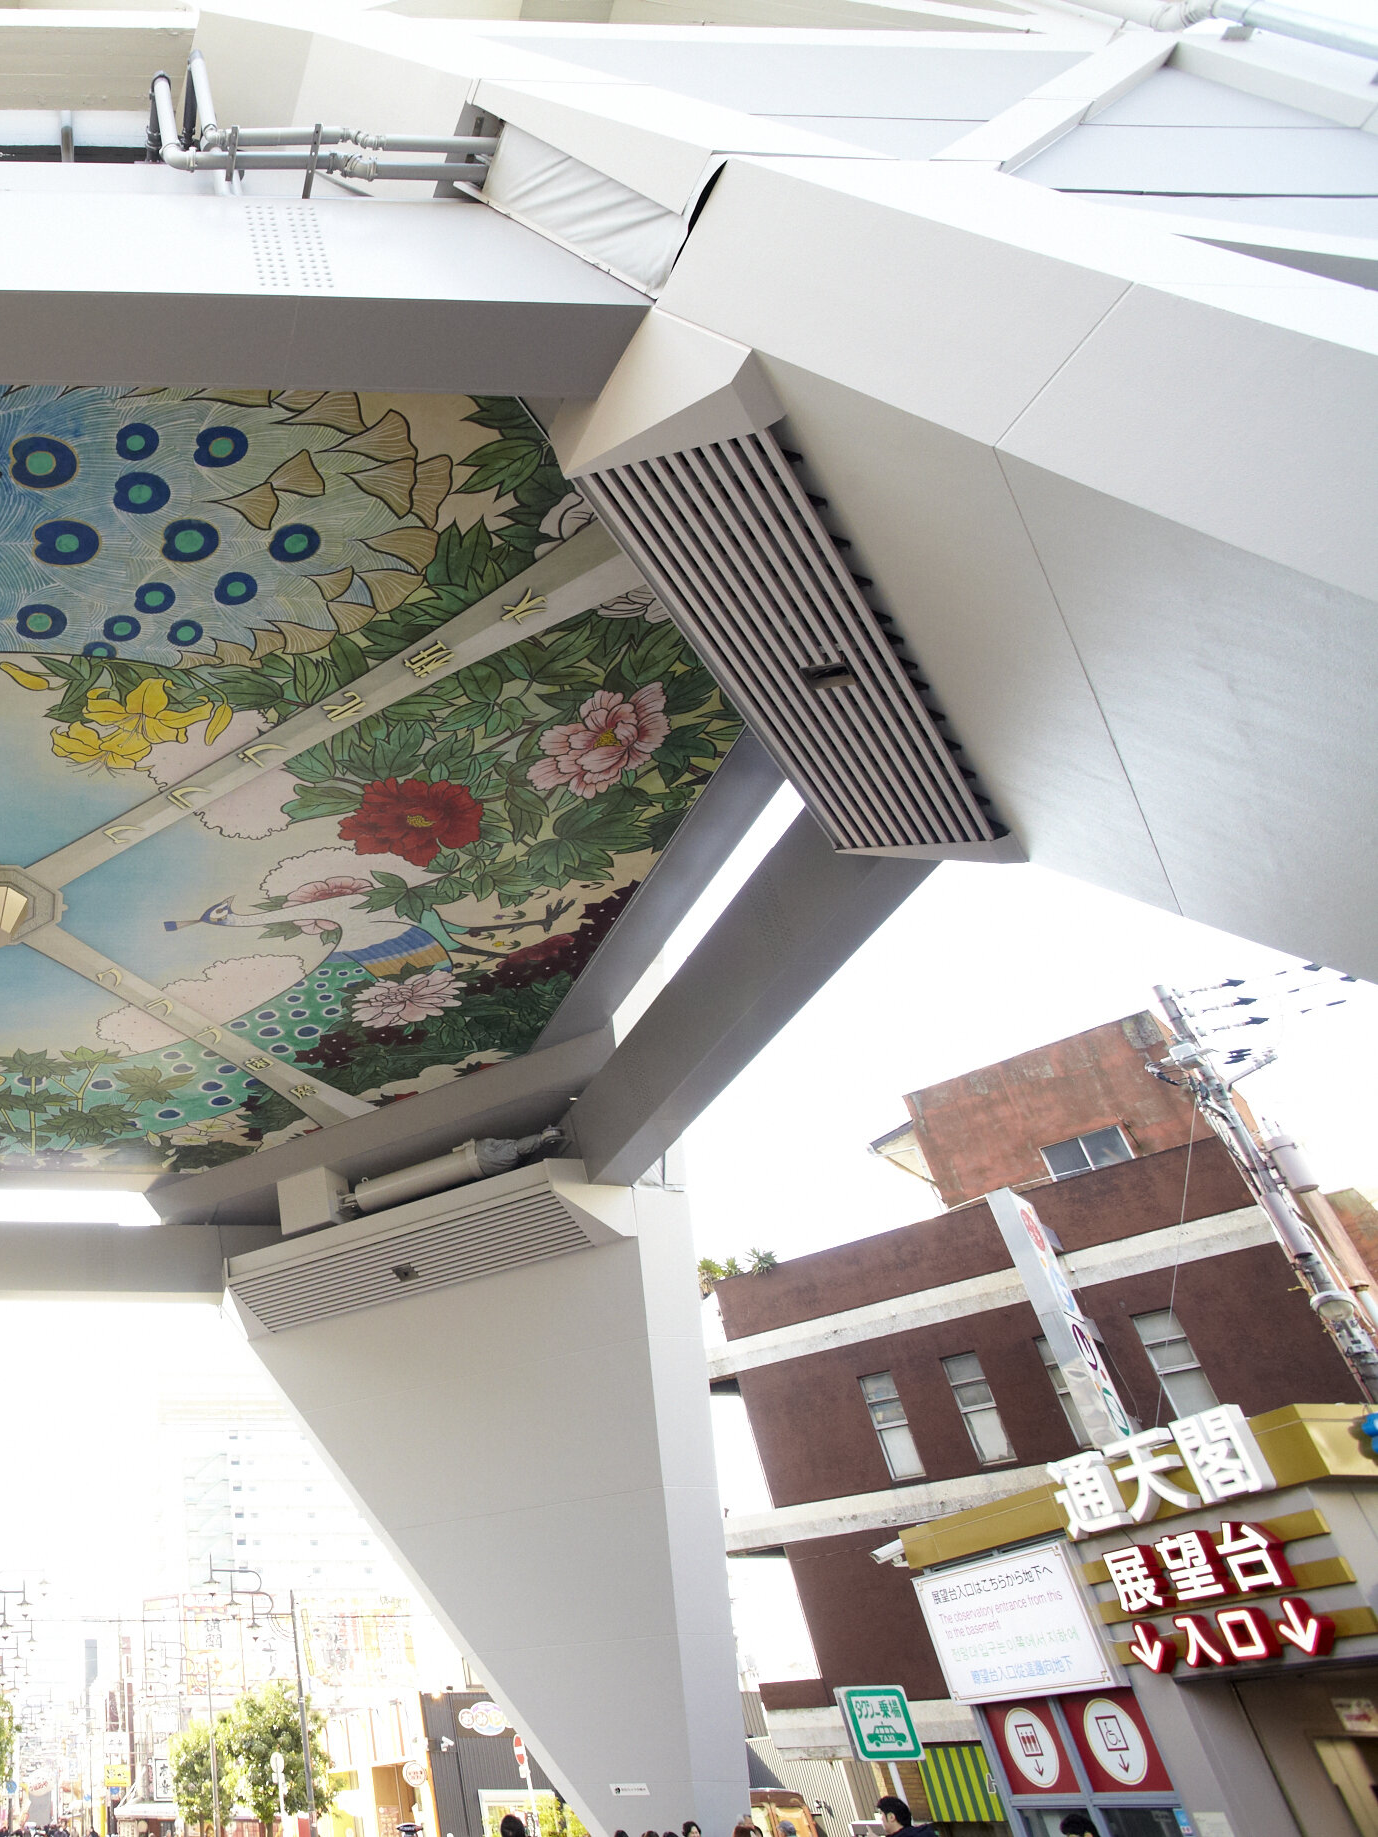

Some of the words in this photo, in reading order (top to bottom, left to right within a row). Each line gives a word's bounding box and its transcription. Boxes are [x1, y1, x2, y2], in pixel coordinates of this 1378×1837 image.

[1047, 1404, 1273, 1538] 通天閣
[931, 1565, 1053, 1605] 展望台入口はこちらから地下へ
[1103, 1521, 1290, 1613] 展望台
[939, 1613, 953, 1624] The
[953, 1605, 994, 1622] observatory
[995, 1598, 1027, 1614] entrance
[1028, 1593, 1045, 1606] from
[1046, 1590, 1063, 1602] this
[945, 1630, 953, 1639] to
[953, 1628, 965, 1638] the
[965, 1619, 1000, 1635] basement
[1172, 1608, 1272, 1667] 入口
[855, 1699, 901, 1719] タクシー乗場
[878, 1734, 896, 1742] TAXI
